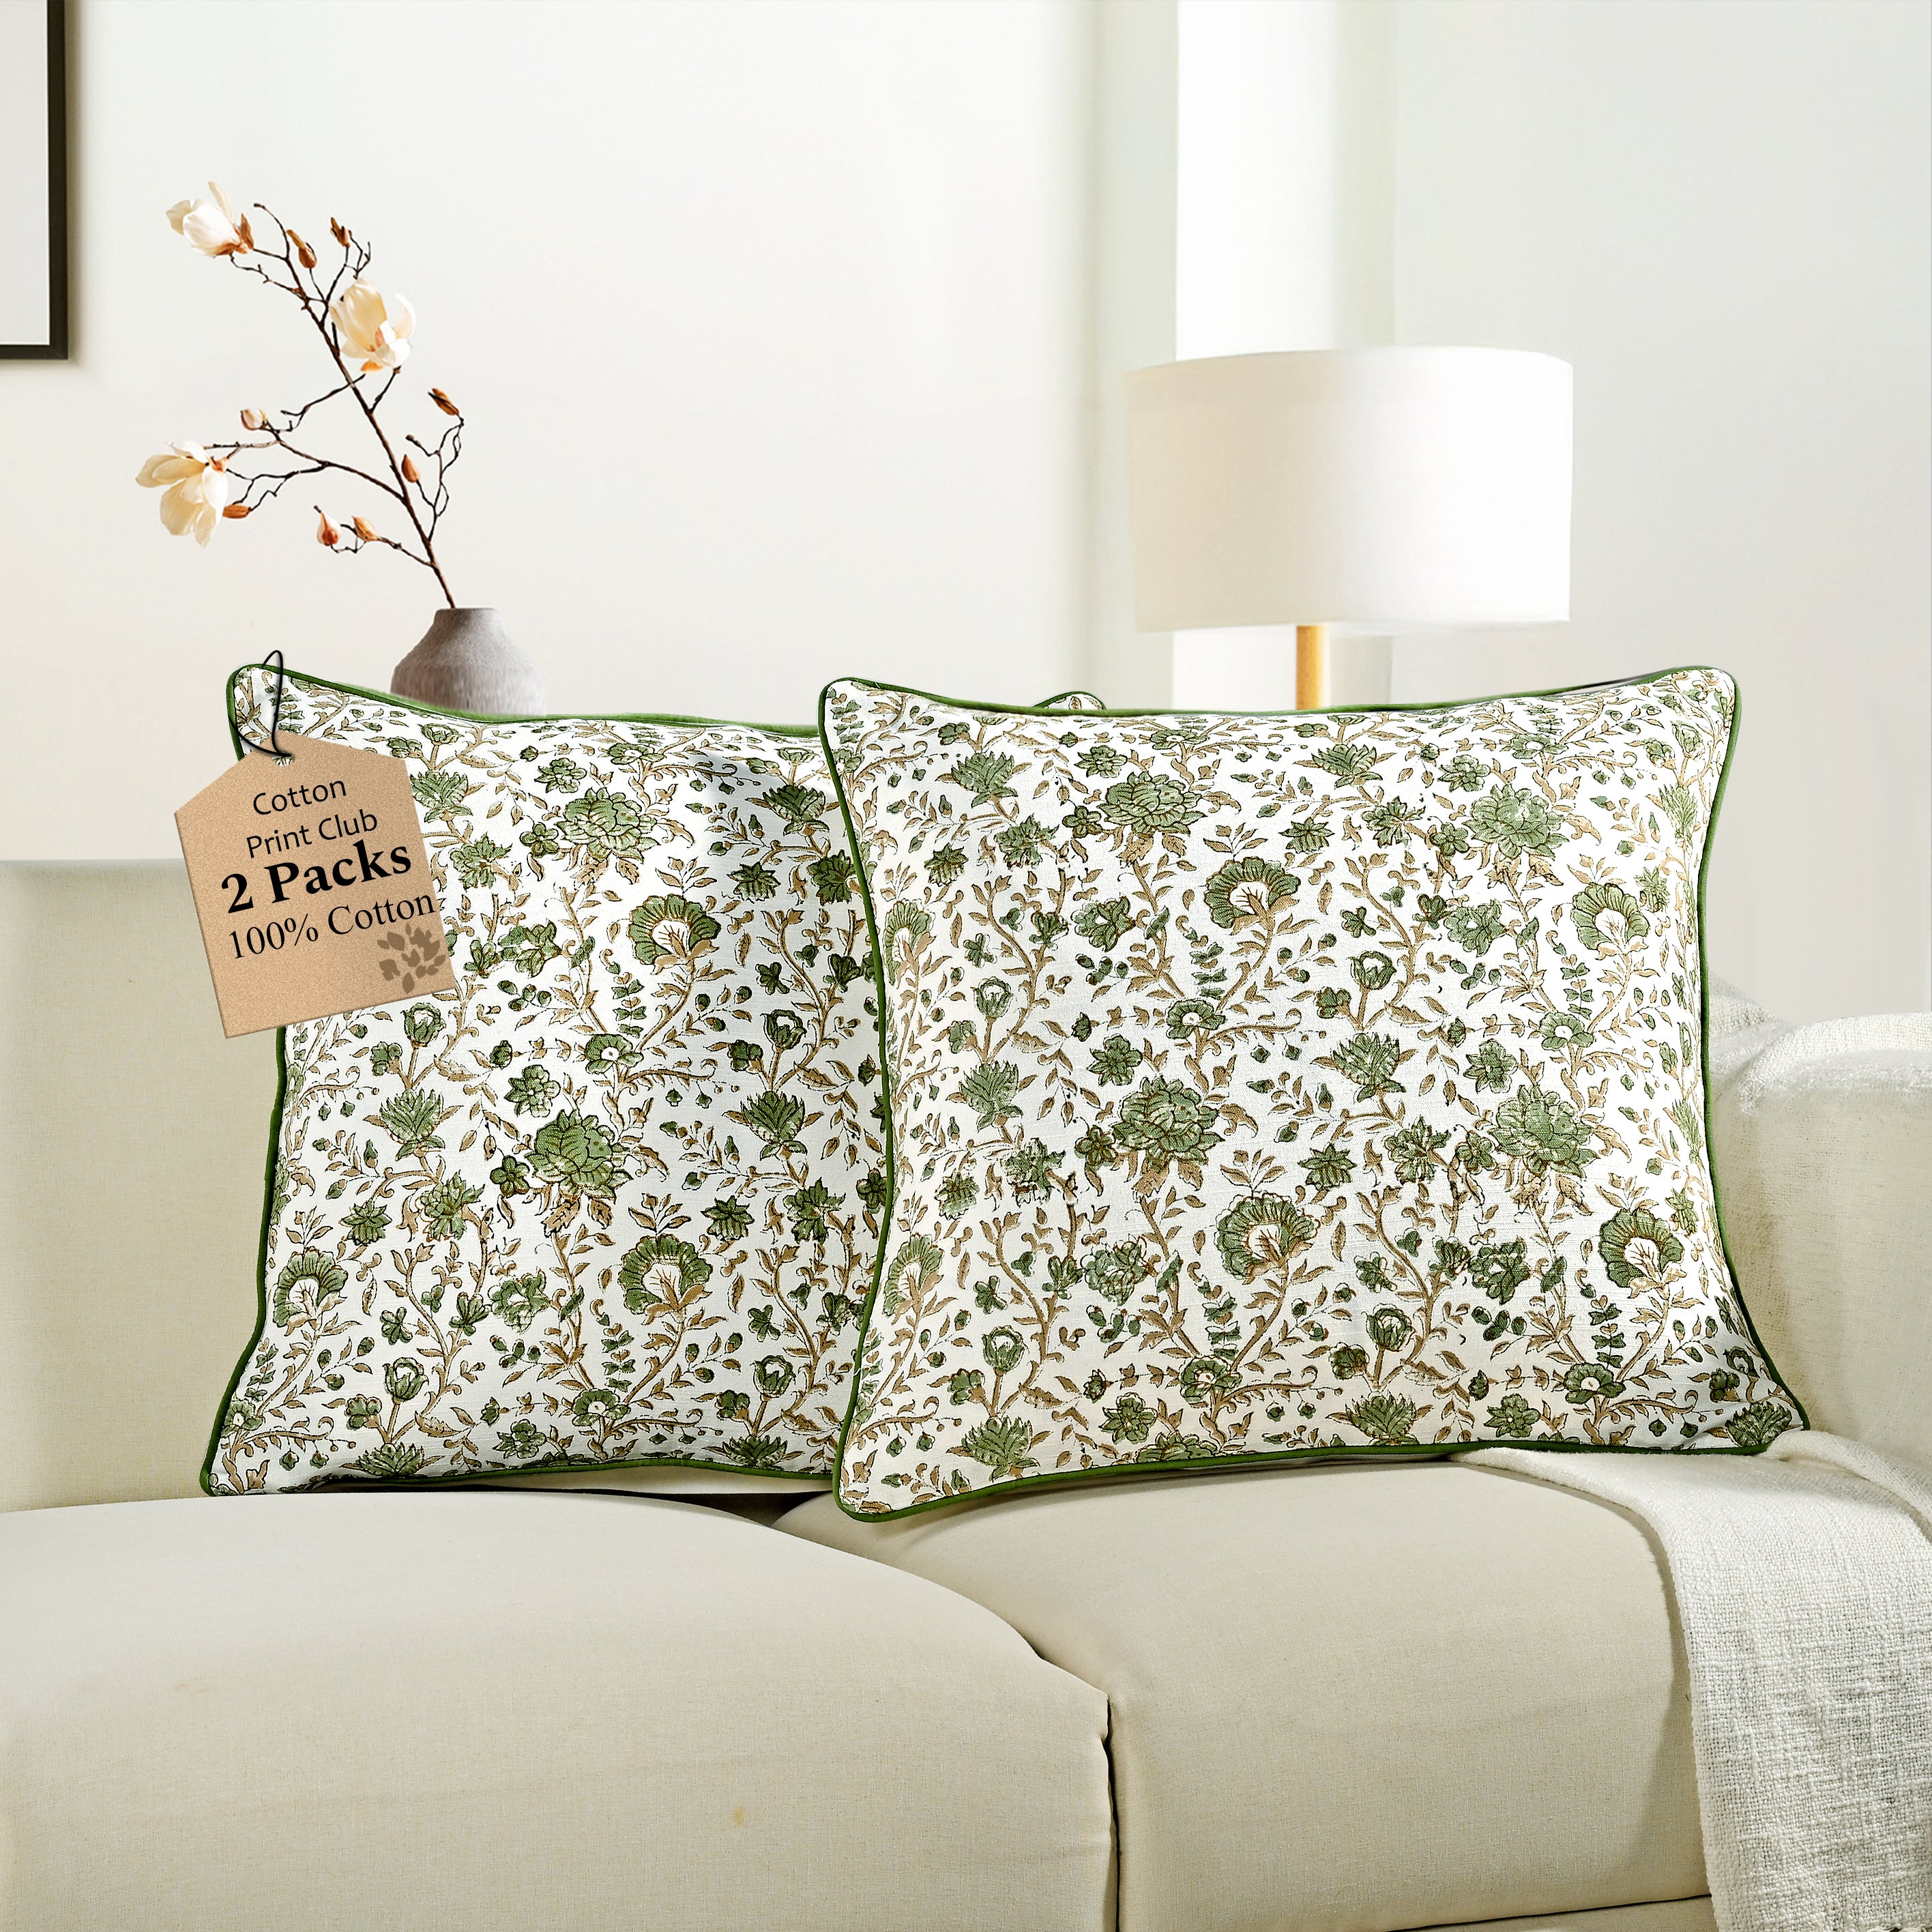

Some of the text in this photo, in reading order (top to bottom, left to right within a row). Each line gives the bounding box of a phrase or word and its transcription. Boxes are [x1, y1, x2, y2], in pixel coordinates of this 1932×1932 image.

[253, 780, 347, 815] Cotton
[246, 808, 377, 859] Print Club
[221, 838, 411, 914] 2 Packs
[229, 894, 436, 959] 100% Cotton
